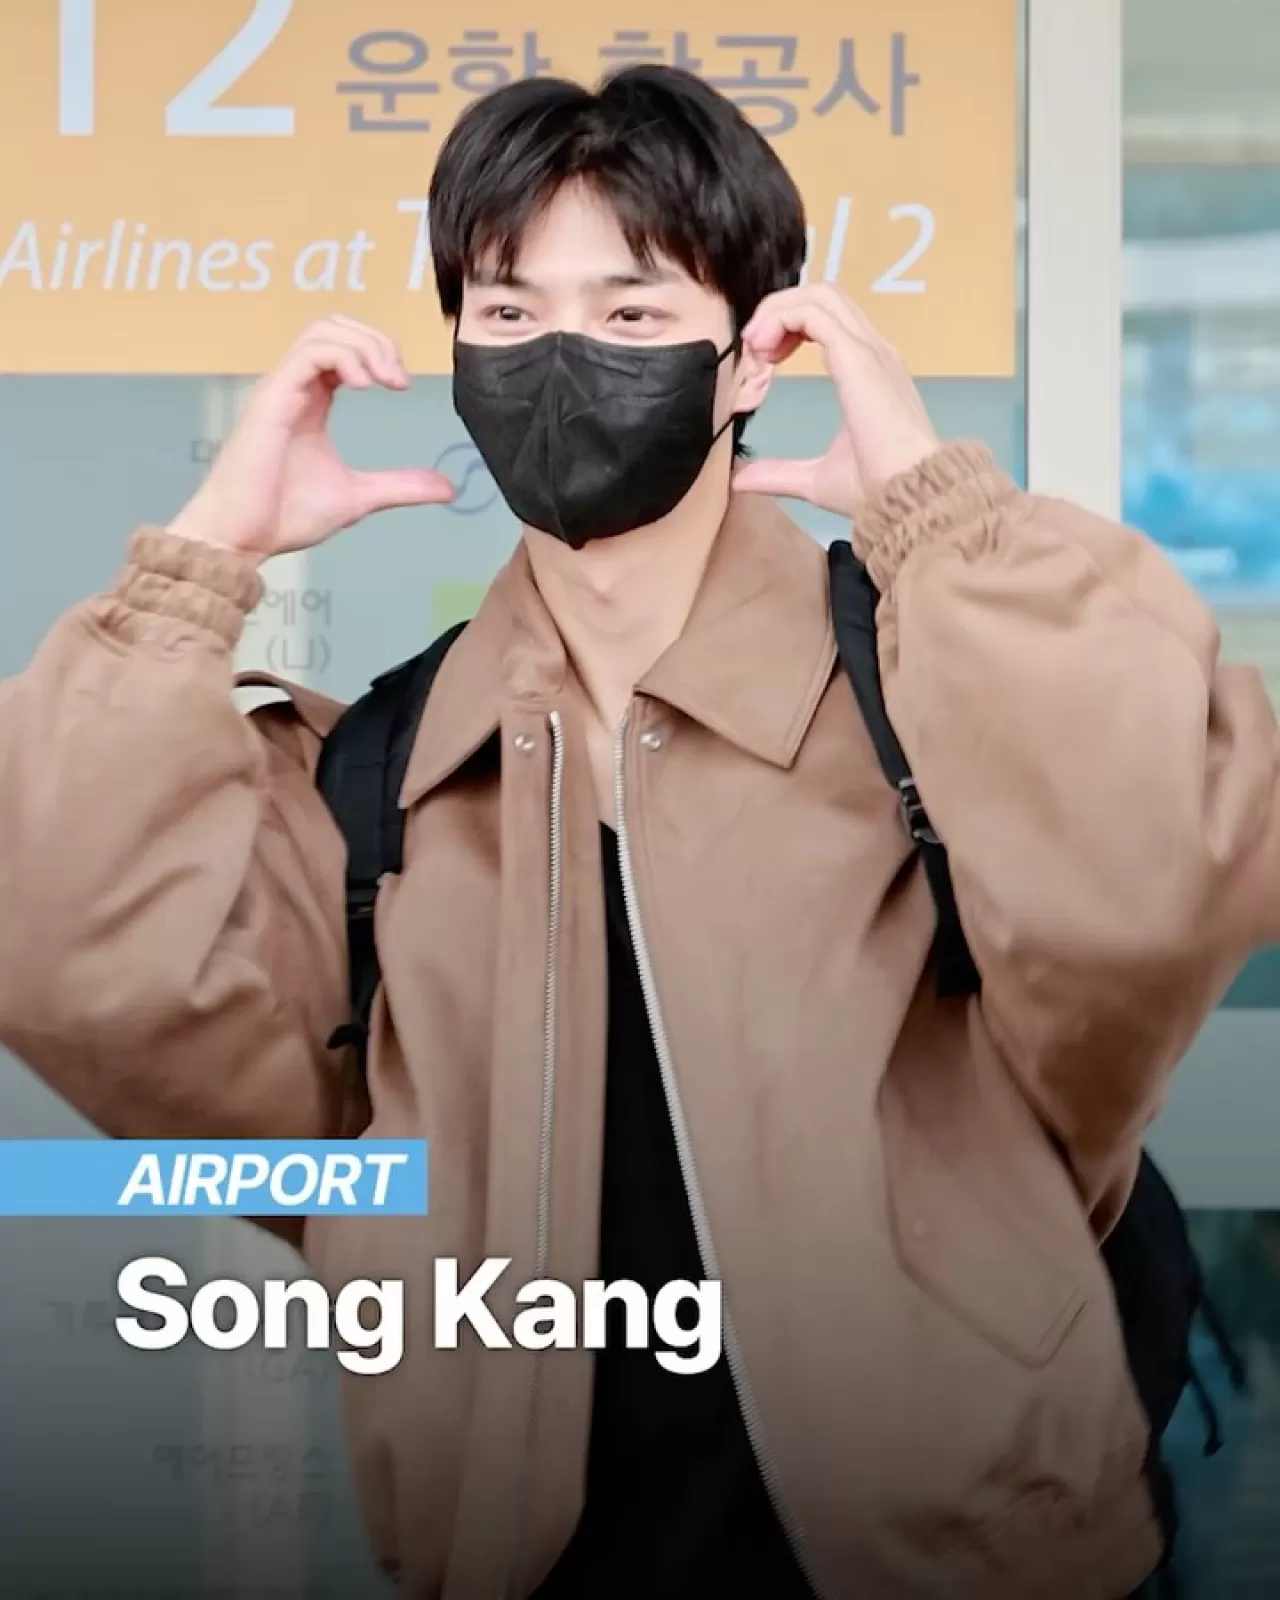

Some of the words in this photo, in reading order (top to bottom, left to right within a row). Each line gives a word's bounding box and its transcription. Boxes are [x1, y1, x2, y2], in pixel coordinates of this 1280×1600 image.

[0, 219, 274, 291] Airlines
[292, 230, 375, 293] at
[869, 202, 936, 294] 2
[243, 587, 334, 628] 에어
